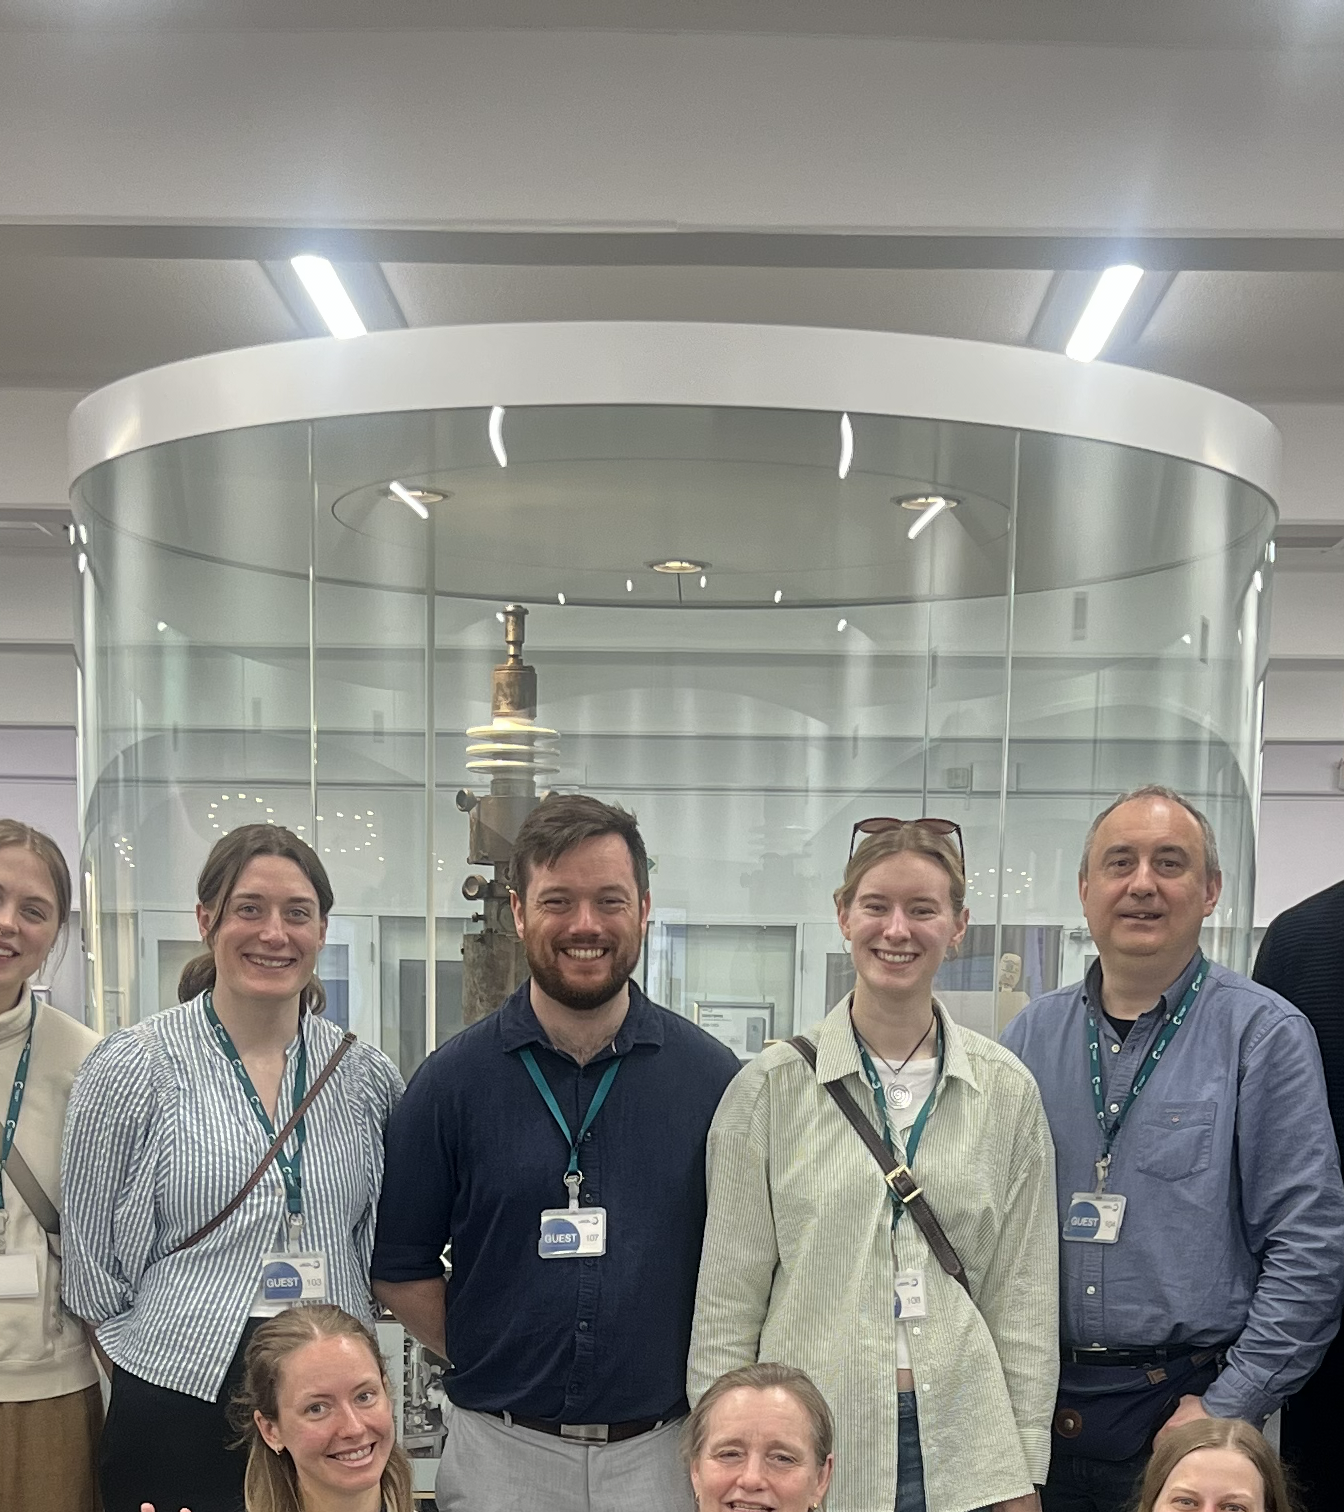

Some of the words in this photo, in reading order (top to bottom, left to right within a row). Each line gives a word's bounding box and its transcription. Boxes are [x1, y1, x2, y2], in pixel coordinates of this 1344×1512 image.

[1070, 1216, 1100, 1227] GUEST
[544, 1233, 578, 1244] GUEST
[266, 1277, 299, 1288] GUEST
[306, 1279, 322, 1287] 103
